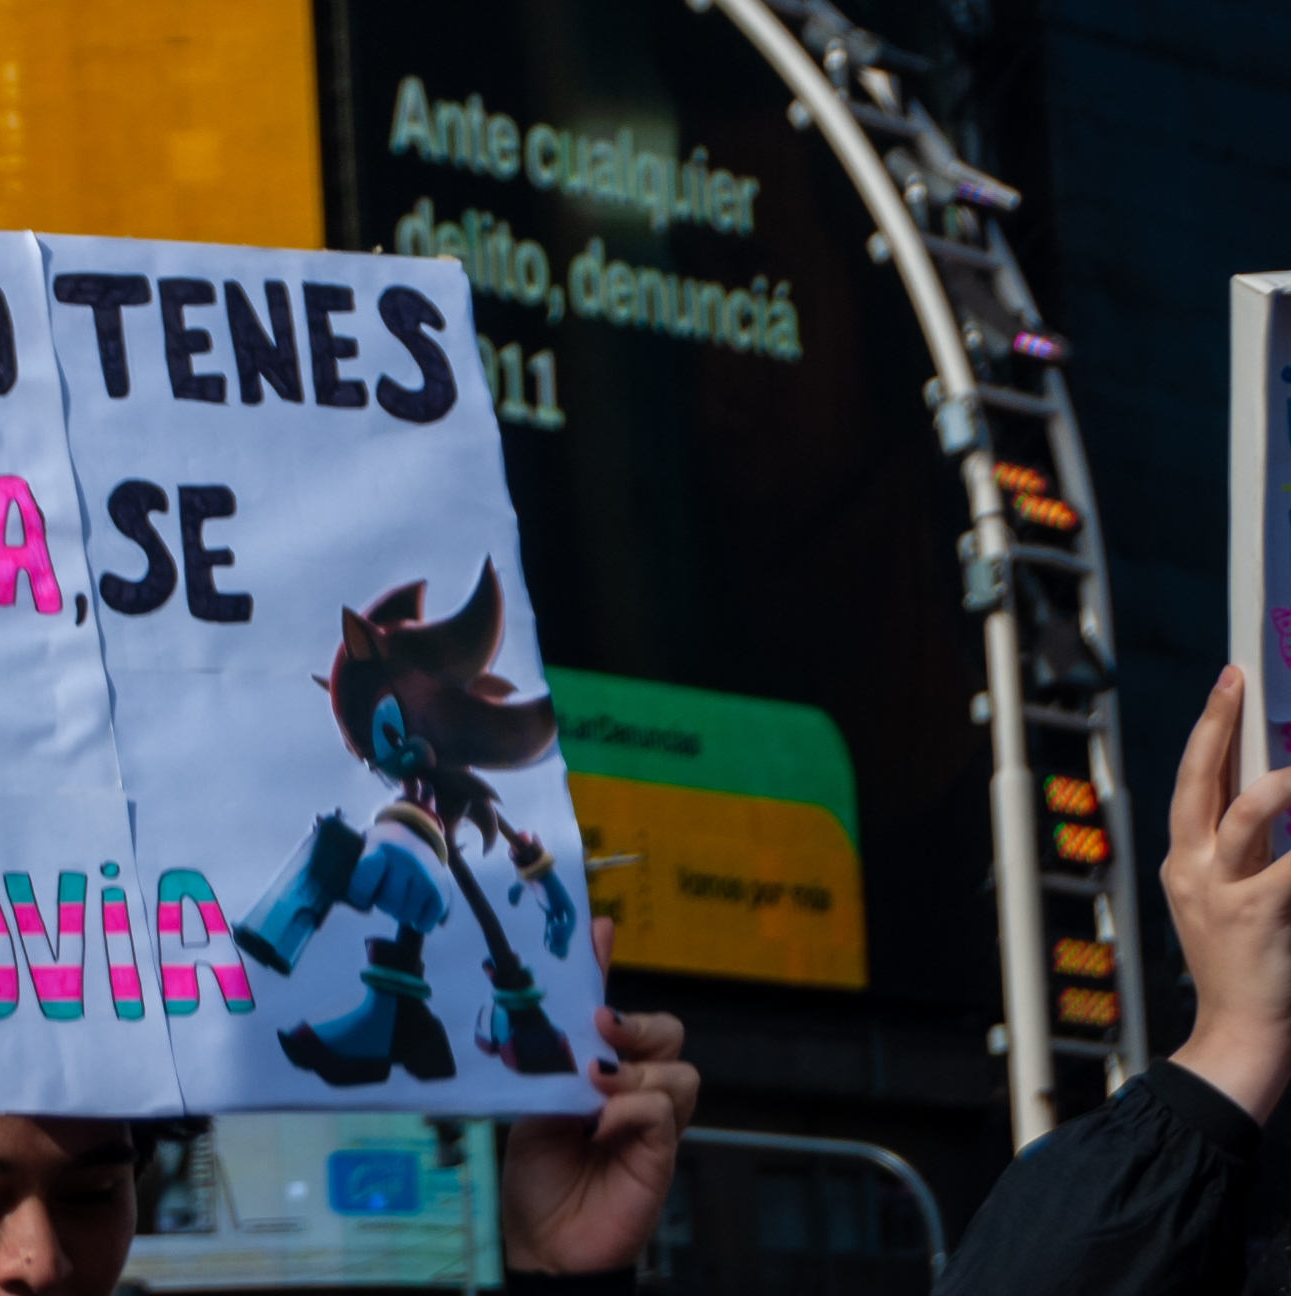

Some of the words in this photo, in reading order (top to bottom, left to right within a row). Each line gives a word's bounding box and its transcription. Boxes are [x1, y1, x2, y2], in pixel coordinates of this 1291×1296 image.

[389, 75, 520, 181] Ante
[524, 121, 761, 236] cualquier
[52, 271, 459, 425] TENES
[98, 478, 255, 623] SE
